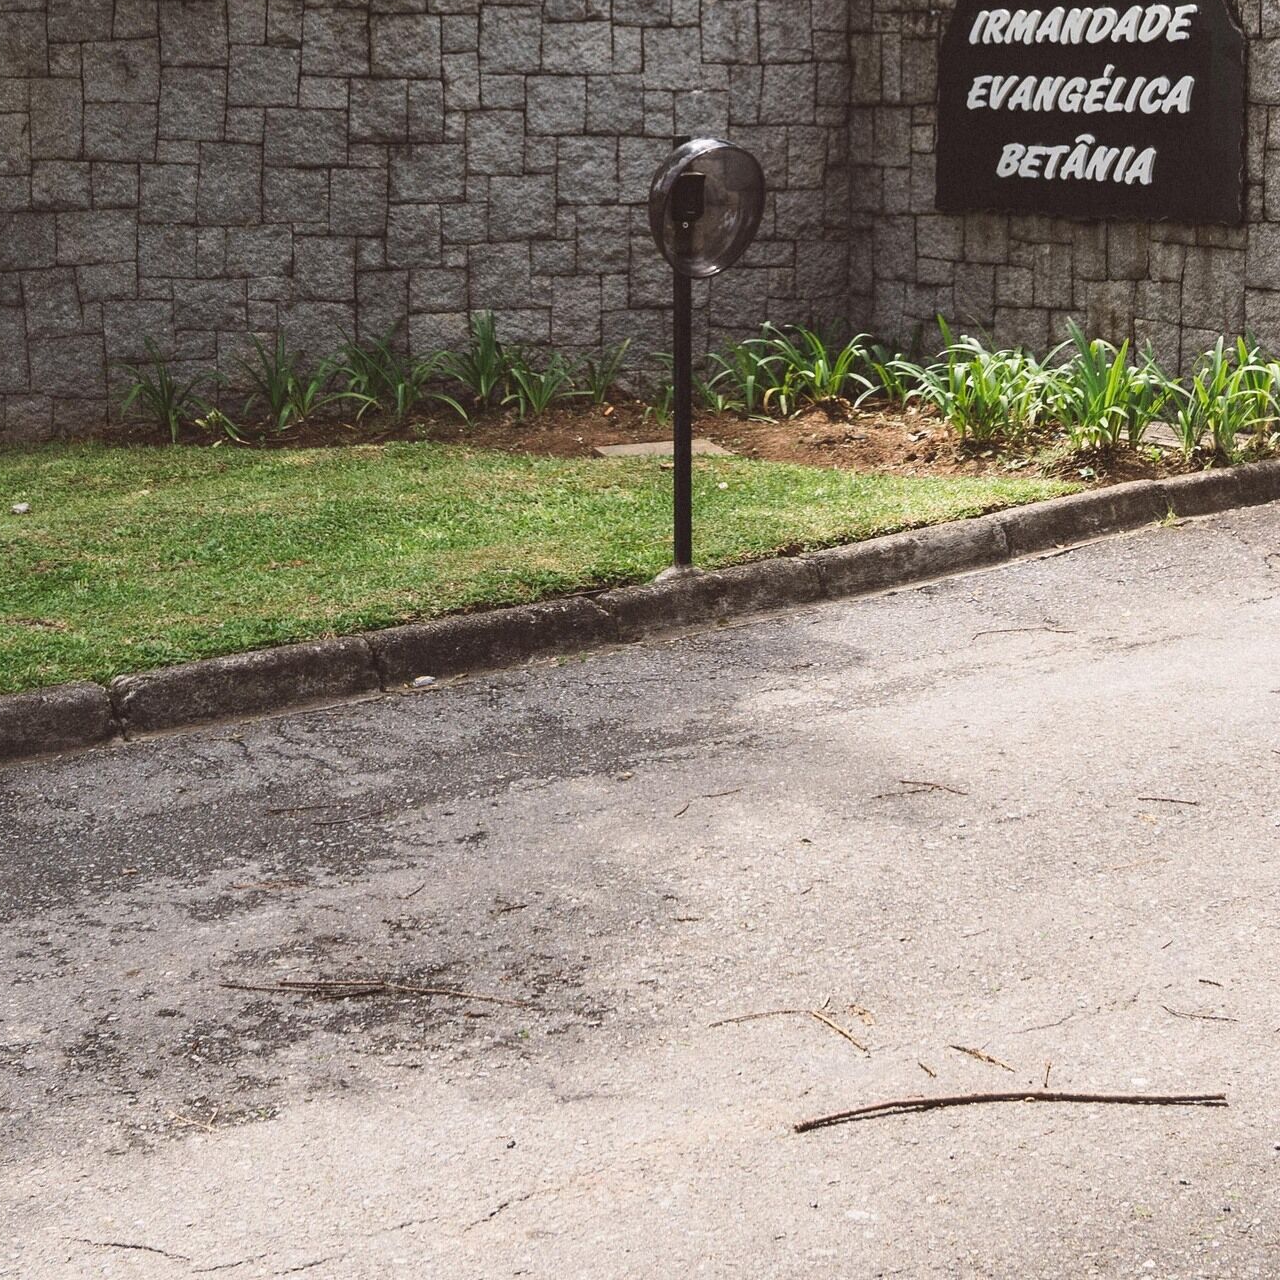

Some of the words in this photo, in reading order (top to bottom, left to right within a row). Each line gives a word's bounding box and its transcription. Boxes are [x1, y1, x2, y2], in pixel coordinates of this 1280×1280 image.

[968, 4, 1198, 45] IRMANDADE
[966, 64, 1196, 114] EVANGÉLICA
[995, 134, 1158, 186] BETÂNIA
